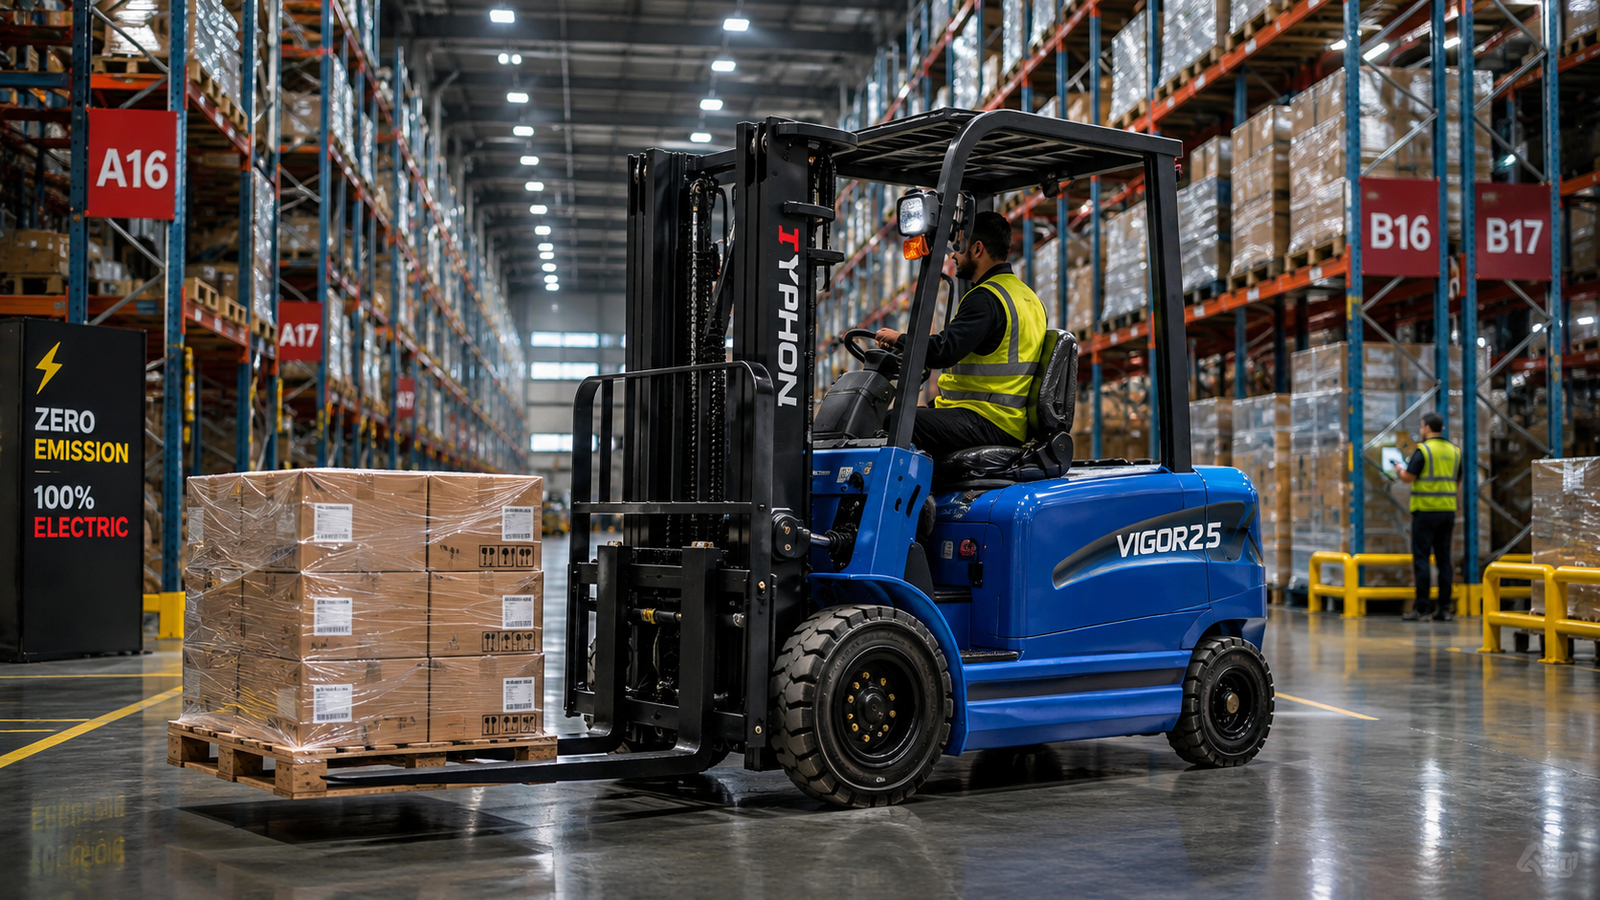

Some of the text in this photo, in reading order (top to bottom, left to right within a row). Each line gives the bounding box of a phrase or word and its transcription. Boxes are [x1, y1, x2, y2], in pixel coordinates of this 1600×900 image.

[96, 148, 169, 190] A16
[1370, 212, 1431, 251] B16
[1486, 217, 1543, 255] B17
[279, 322, 320, 348] A17
[34, 407, 95, 434] ZERO
[34, 438, 129, 464] EMISSION
[33, 485, 95, 510] 100%
[33, 516, 129, 539] ELECTRIC
[1116, 521, 1222, 558] VIGOR25
